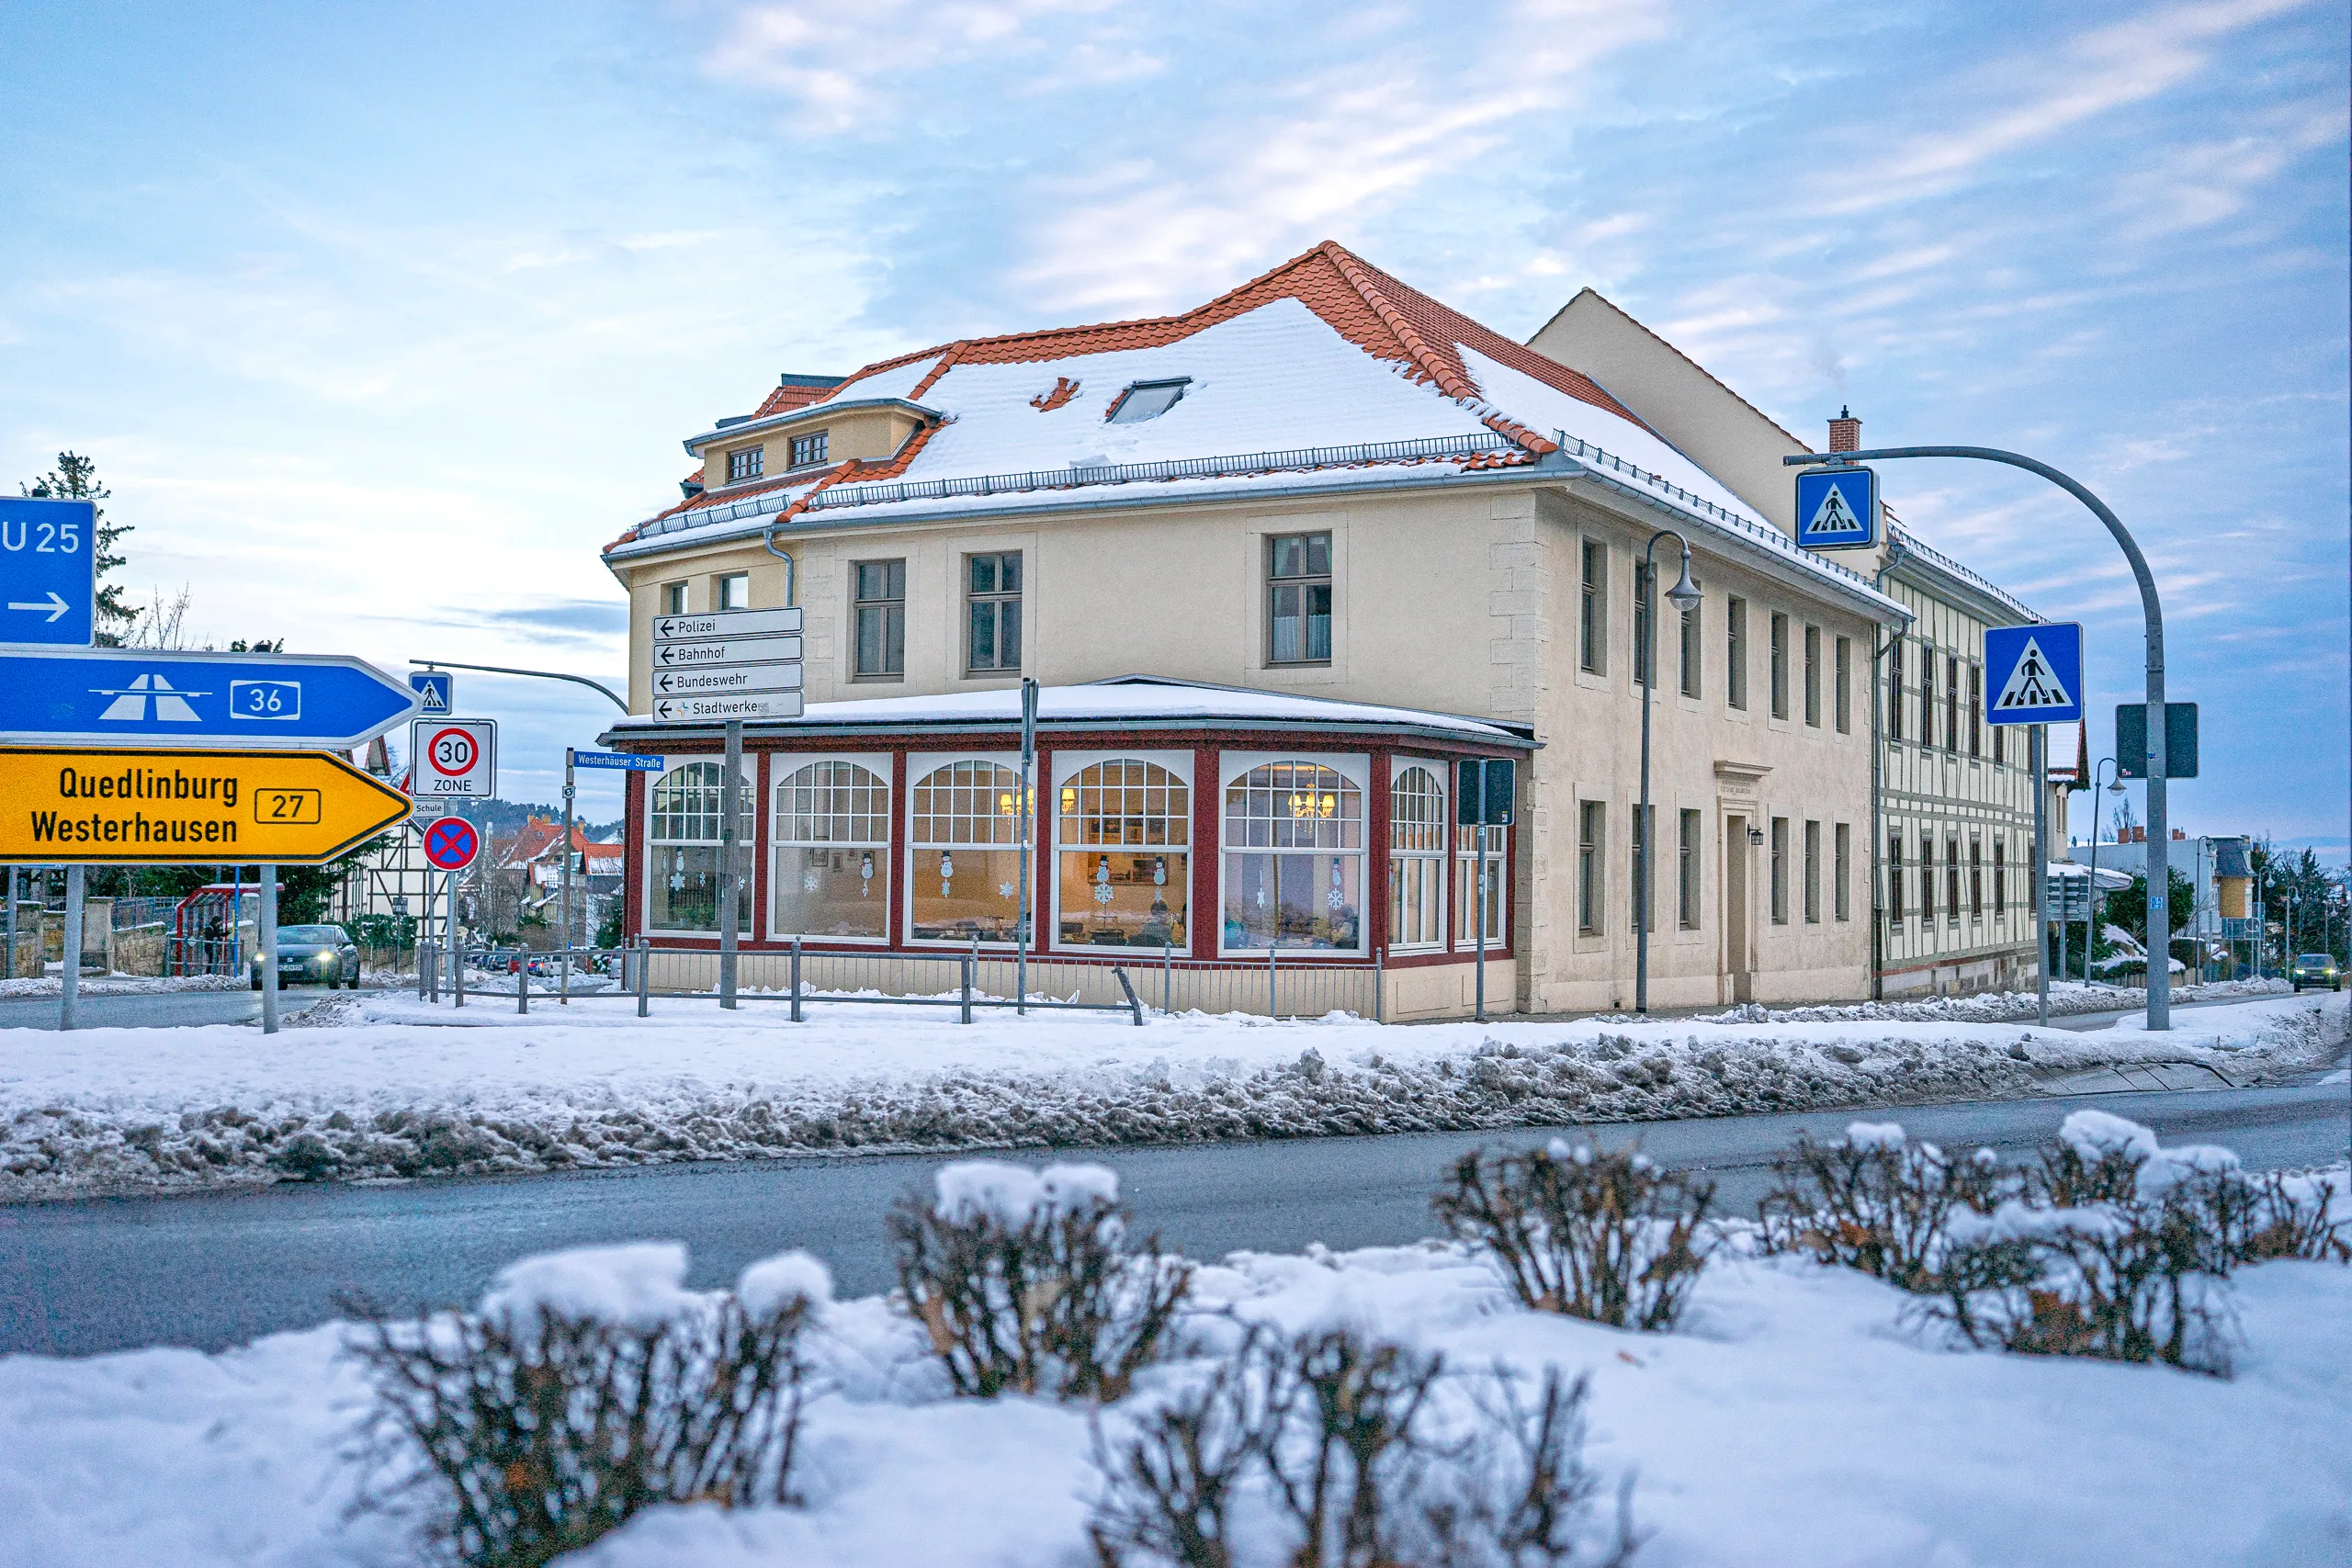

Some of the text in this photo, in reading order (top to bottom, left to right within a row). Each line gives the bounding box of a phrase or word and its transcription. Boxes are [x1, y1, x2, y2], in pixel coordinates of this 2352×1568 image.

[678, 619, 716, 634] Polizei
[678, 646, 726, 660] Bahnhof
[677, 673, 749, 688] Bundeswehr
[249, 688, 282, 712] 36
[693, 700, 758, 715] Stadtwerke
[438, 740, 469, 763] 30
[578, 754, 661, 769] Westerhäuser Straße
[59, 767, 238, 808] Quedlinburg
[434, 779, 472, 792] ZONE
[271, 795, 304, 818] 27
[416, 804, 442, 812] Schule
[30, 810, 237, 843] Westerhausen
